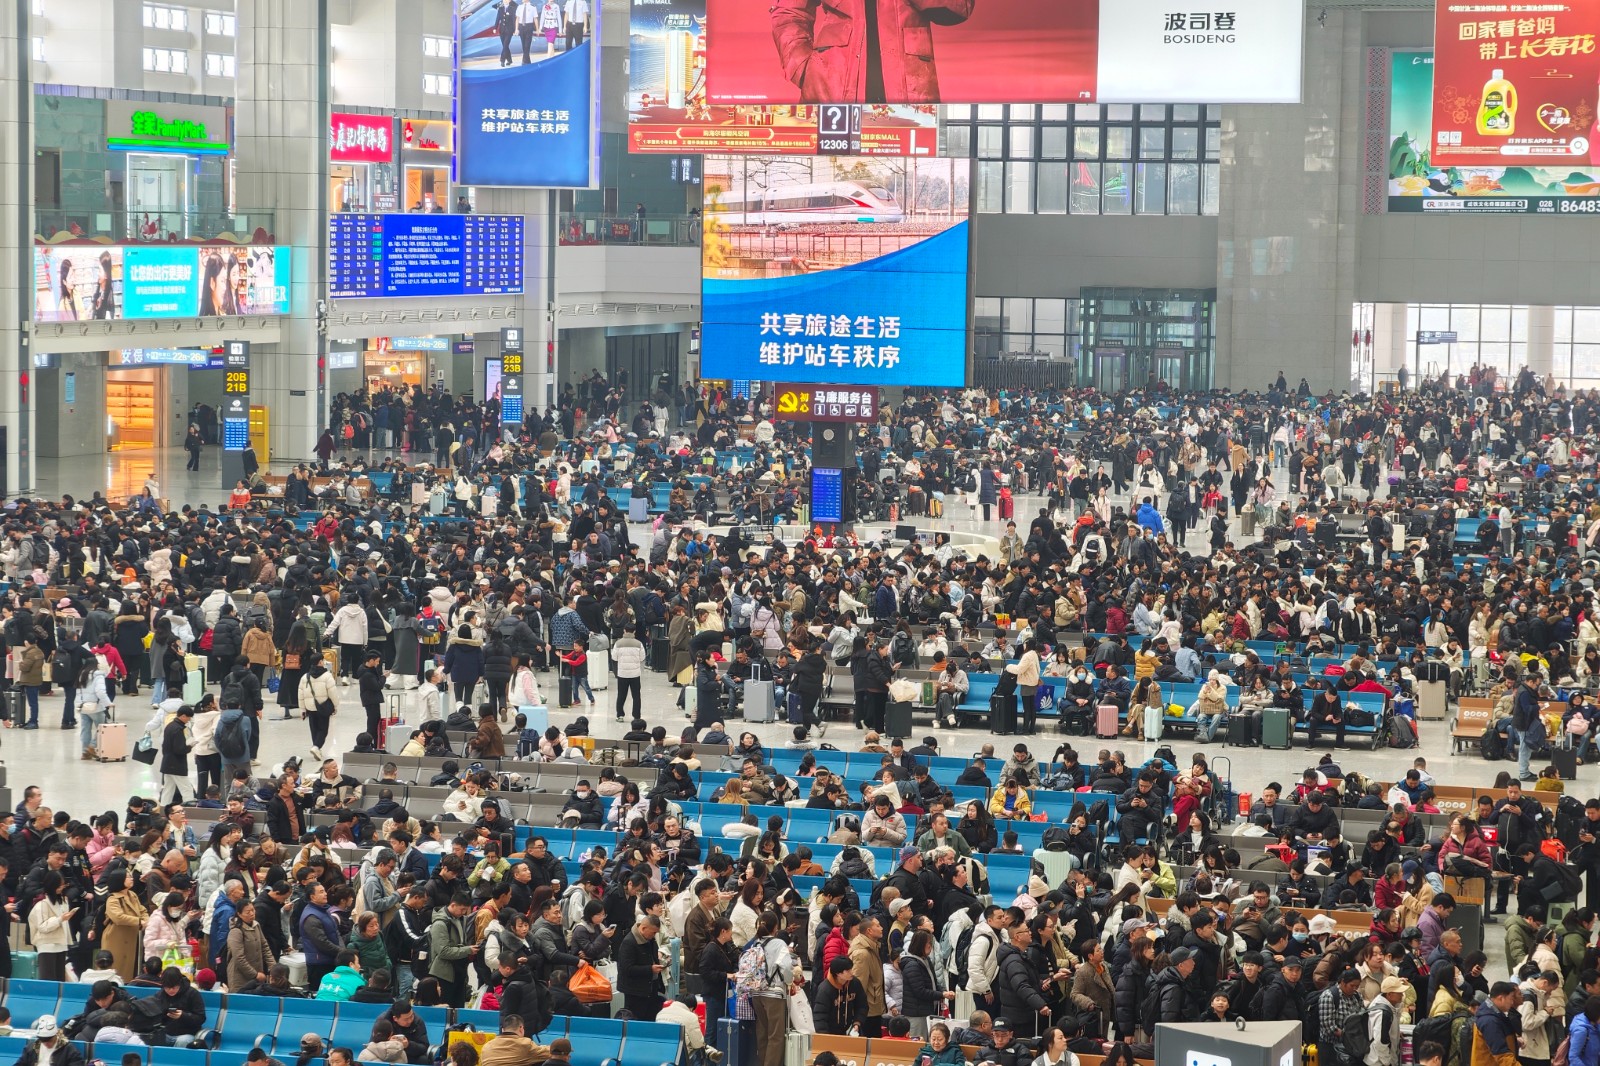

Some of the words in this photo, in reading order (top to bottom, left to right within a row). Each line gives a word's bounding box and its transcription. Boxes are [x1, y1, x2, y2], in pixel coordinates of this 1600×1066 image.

[1164, 12, 1236, 31] 波司登
[1458, 17, 1556, 41] 回家看爸妈
[1163, 34, 1236, 44] BOSIDENG
[1479, 34, 1596, 60] 带上长寿花
[481, 108, 570, 121] 共享旅途生活
[131, 110, 156, 135] 全家
[156, 117, 207, 141] FamilyMart
[481, 121, 570, 135] 维护站车秩序
[819, 139, 848, 150] 12306
[759, 312, 901, 339] 共享旅途生活
[503, 355, 521, 364] 22B
[759, 341, 901, 369] 维护站车秩序
[503, 364, 521, 373] 23B
[226, 372, 247, 382] 20B
[226, 382, 247, 392] 21B
